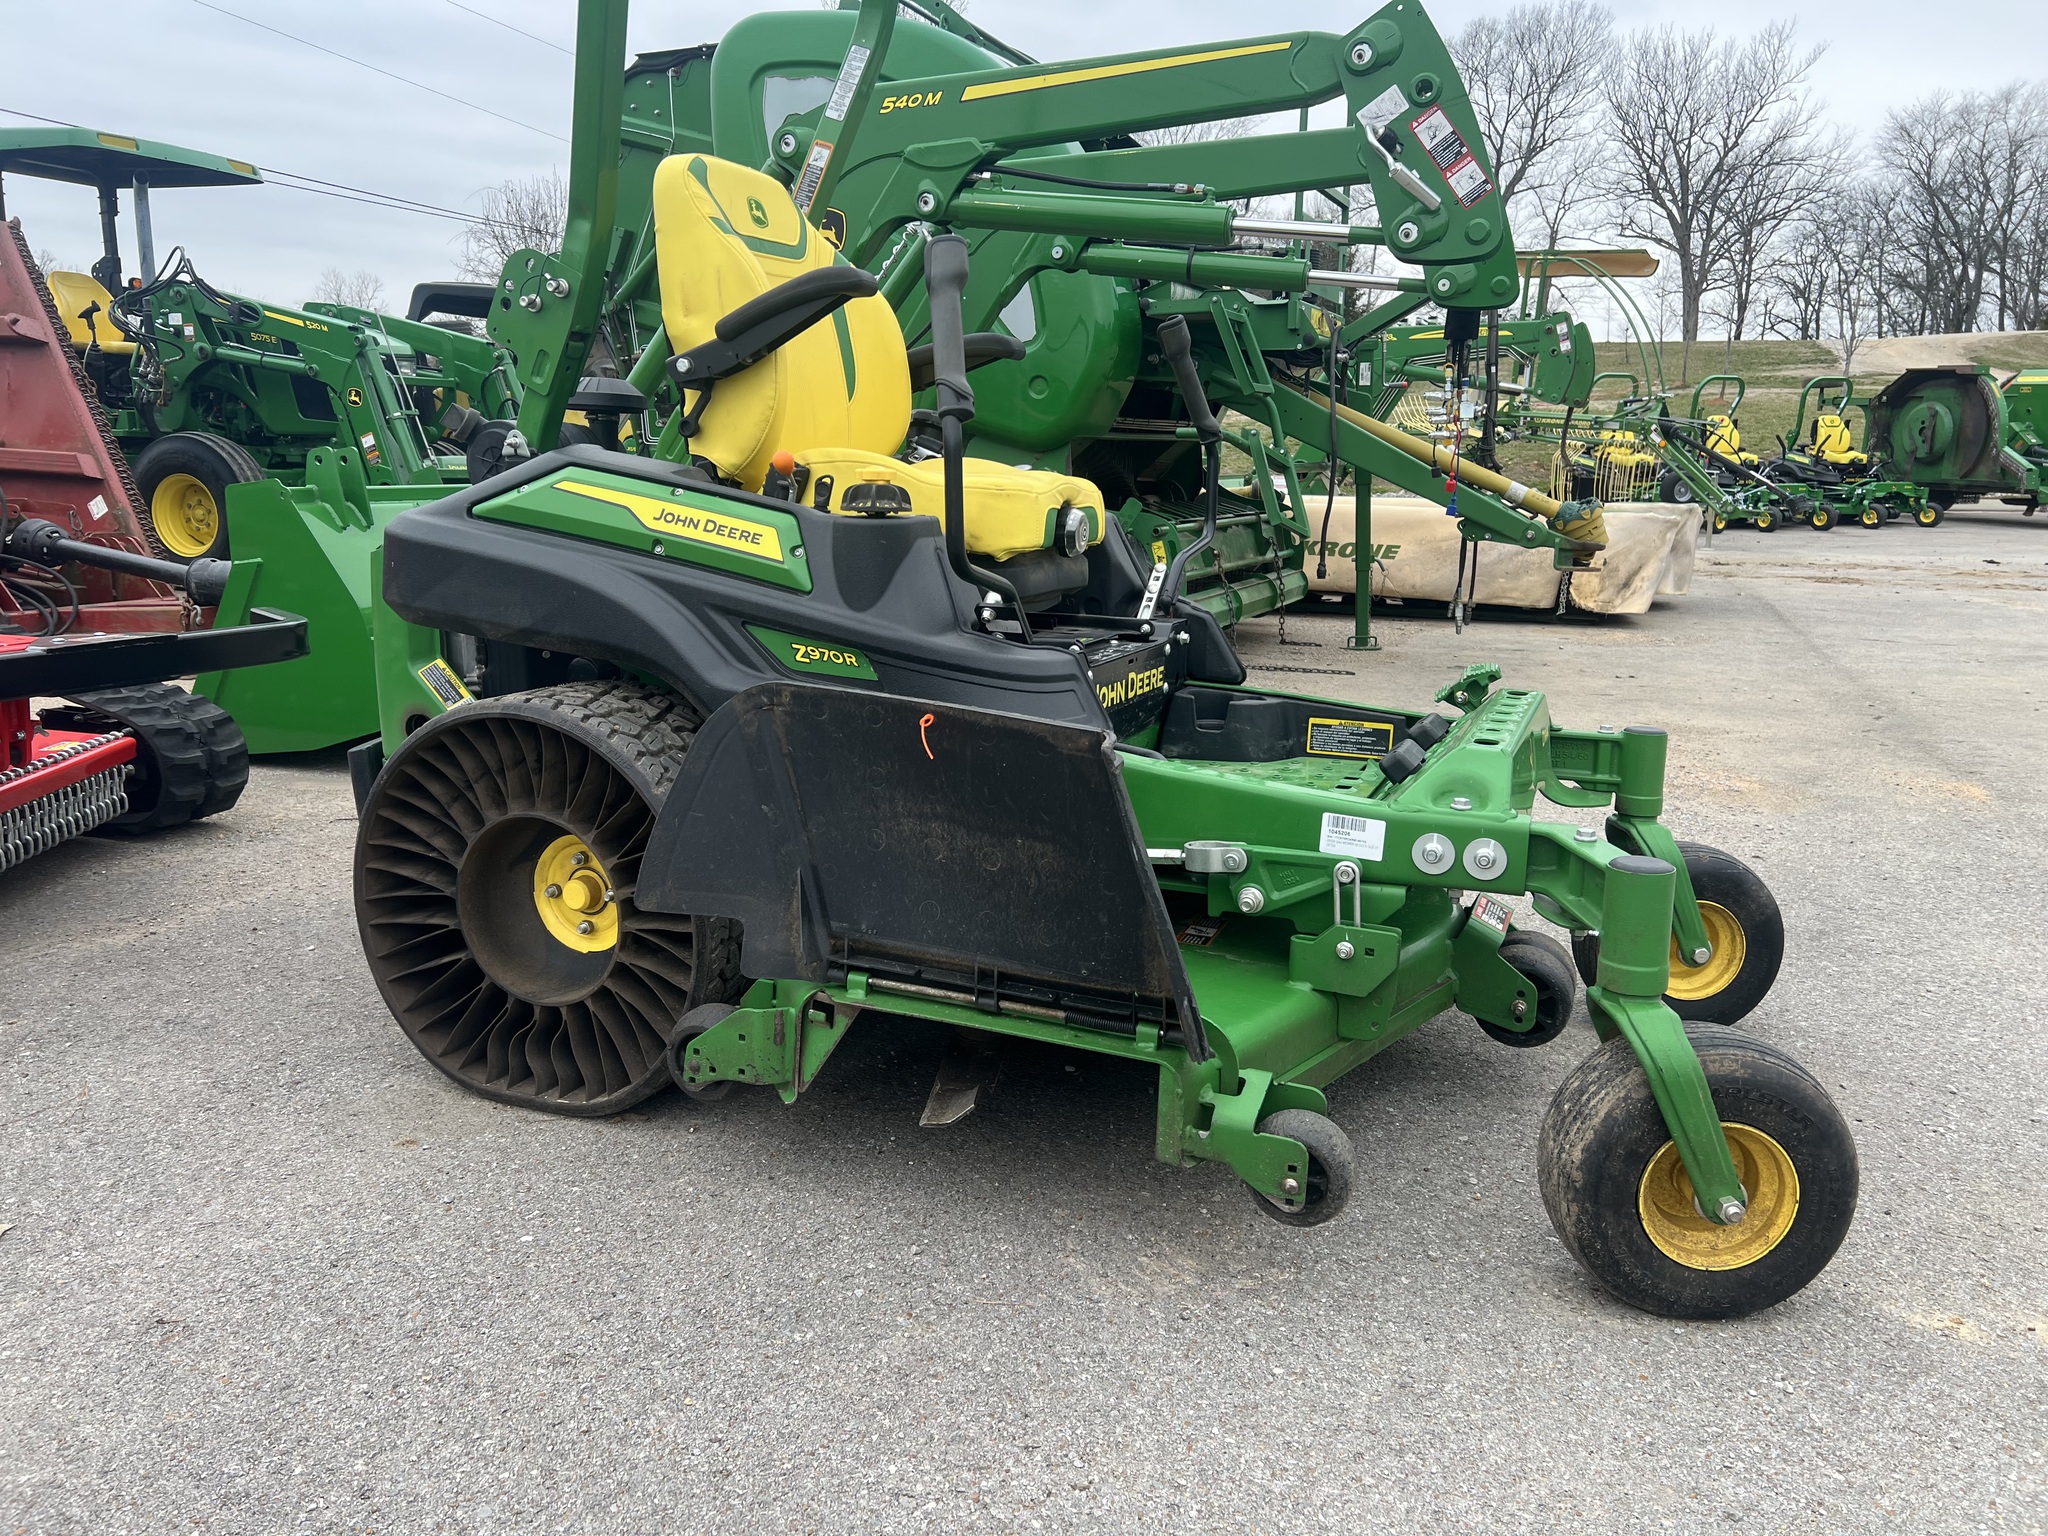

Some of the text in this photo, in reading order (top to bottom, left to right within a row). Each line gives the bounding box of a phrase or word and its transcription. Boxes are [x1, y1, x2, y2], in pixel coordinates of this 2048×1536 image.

[652, 508, 764, 545] JOHN DEERE
[790, 642, 860, 668] Z970R
[1128, 665, 1165, 700] DEERE
[1710, 1086, 1814, 1132] ARLSTAR
